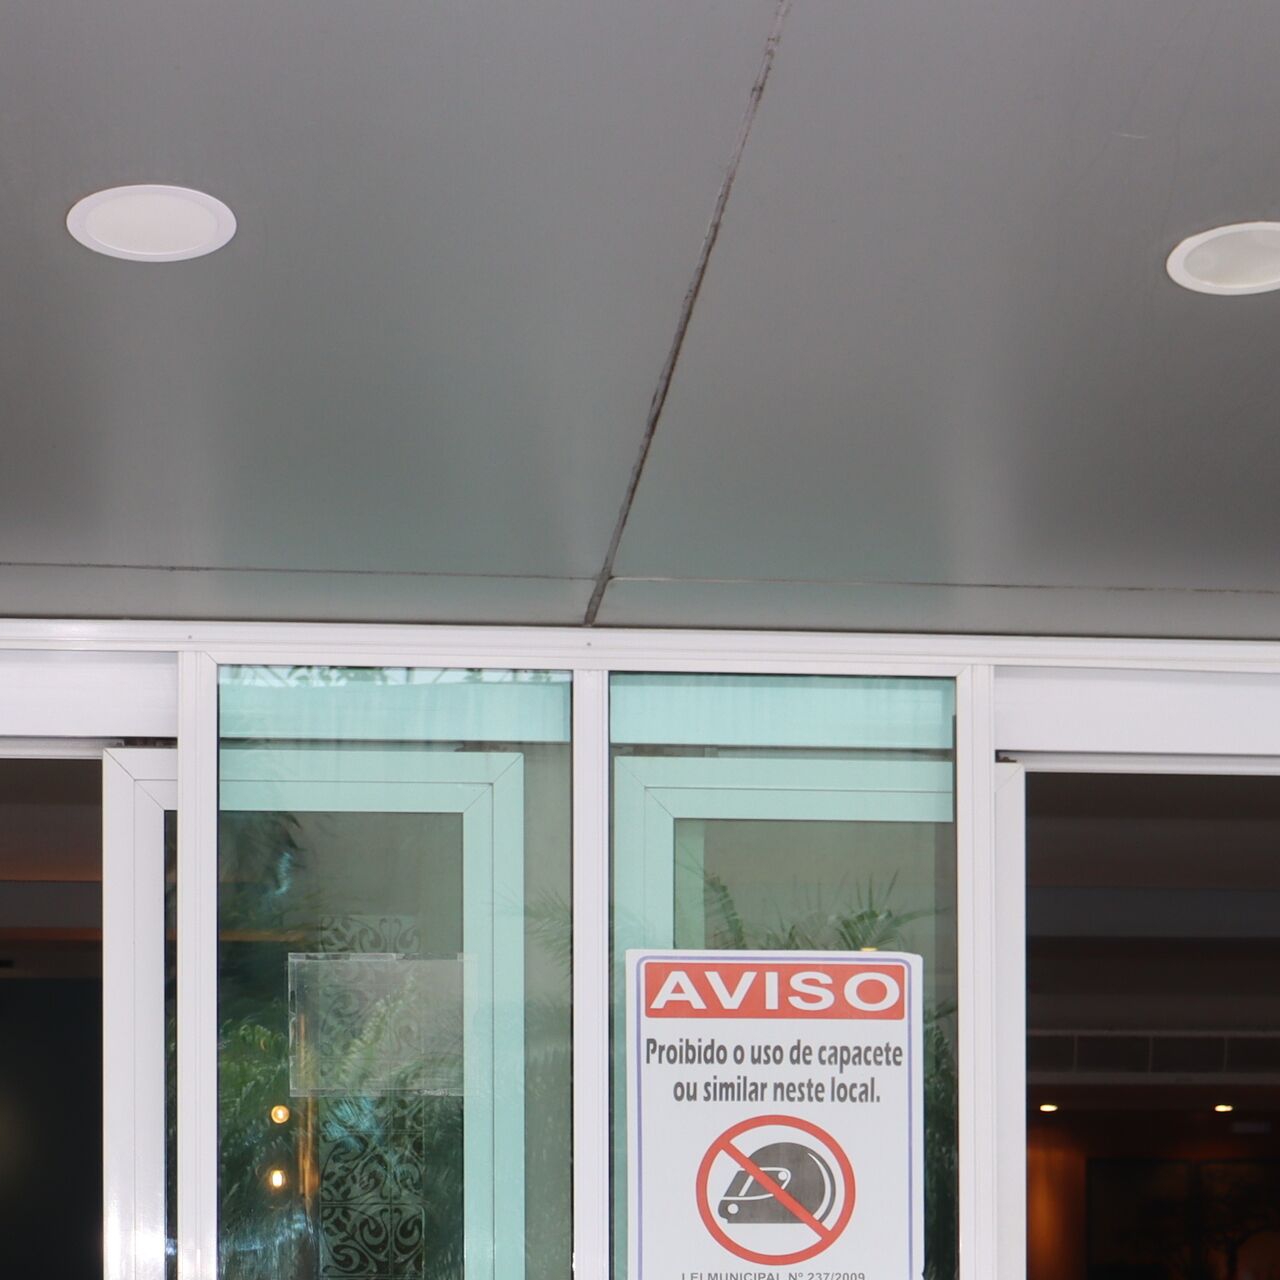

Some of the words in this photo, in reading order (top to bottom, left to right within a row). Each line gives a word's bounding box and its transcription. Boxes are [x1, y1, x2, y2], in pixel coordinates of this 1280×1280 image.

[650, 970, 900, 1011] AVISO
[646, 1037, 728, 1066] Proibido
[733, 1043, 745, 1066] o
[751, 1043, 784, 1067] uso
[789, 1039, 813, 1067] de
[817, 1041, 904, 1075] capacete
[673, 1080, 698, 1103] ou
[703, 1075, 768, 1103] similar
[773, 1077, 825, 1103] neste
[830, 1077, 881, 1104] local.
